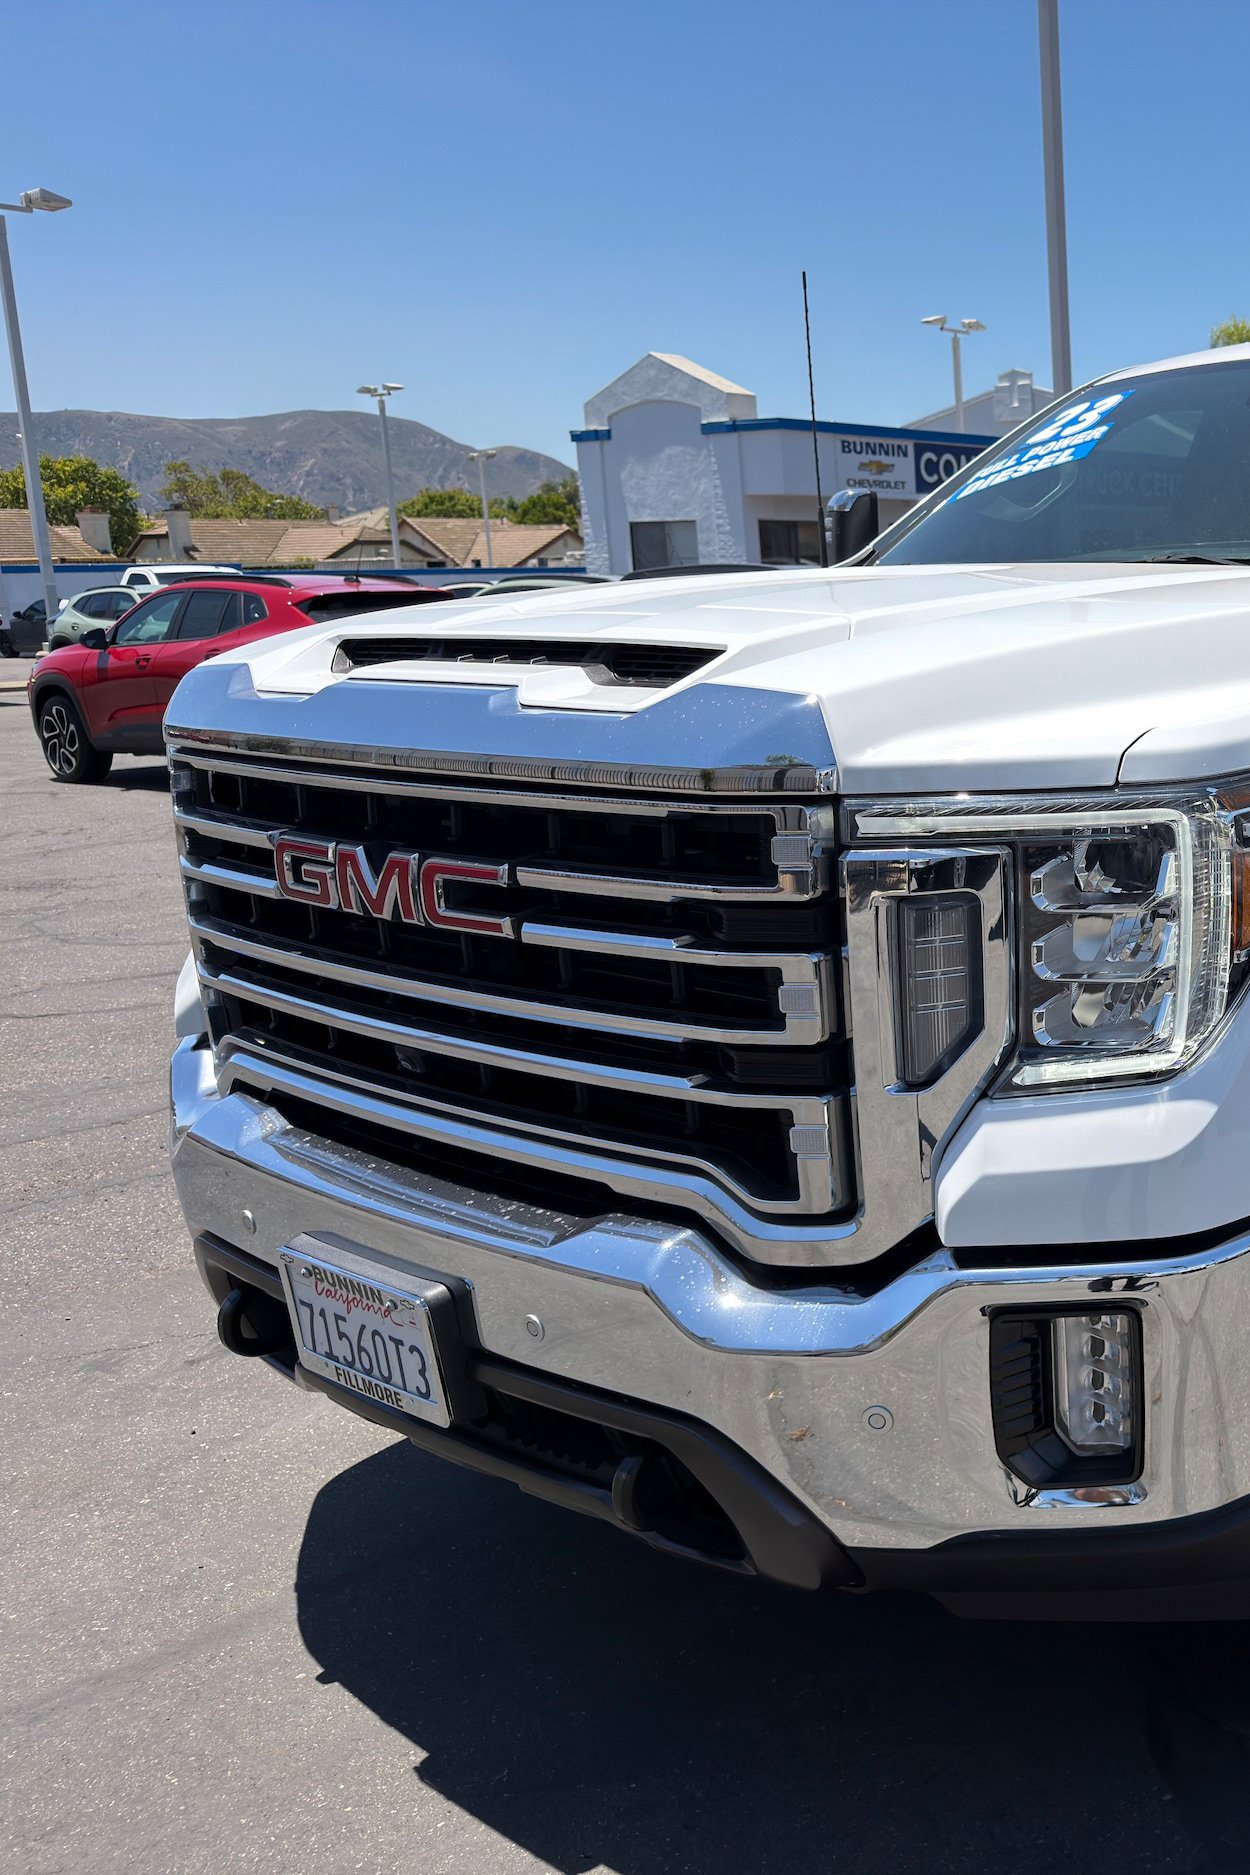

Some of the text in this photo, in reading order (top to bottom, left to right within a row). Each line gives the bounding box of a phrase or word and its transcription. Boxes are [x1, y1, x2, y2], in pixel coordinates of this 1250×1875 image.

[1026, 394, 1123, 444] 23
[840, 439, 909, 457] BUNNIN
[1021, 425, 1109, 462] POWER
[846, 478, 907, 490] CHEVROLET
[955, 447, 1076, 500] DIESEL
[274, 832, 515, 939] GMC
[311, 1264, 384, 1307] BUNNIN
[314, 1280, 404, 1327] California
[299, 1298, 431, 1400] 71560T3
[334, 1366, 404, 1410] FILLMORE
